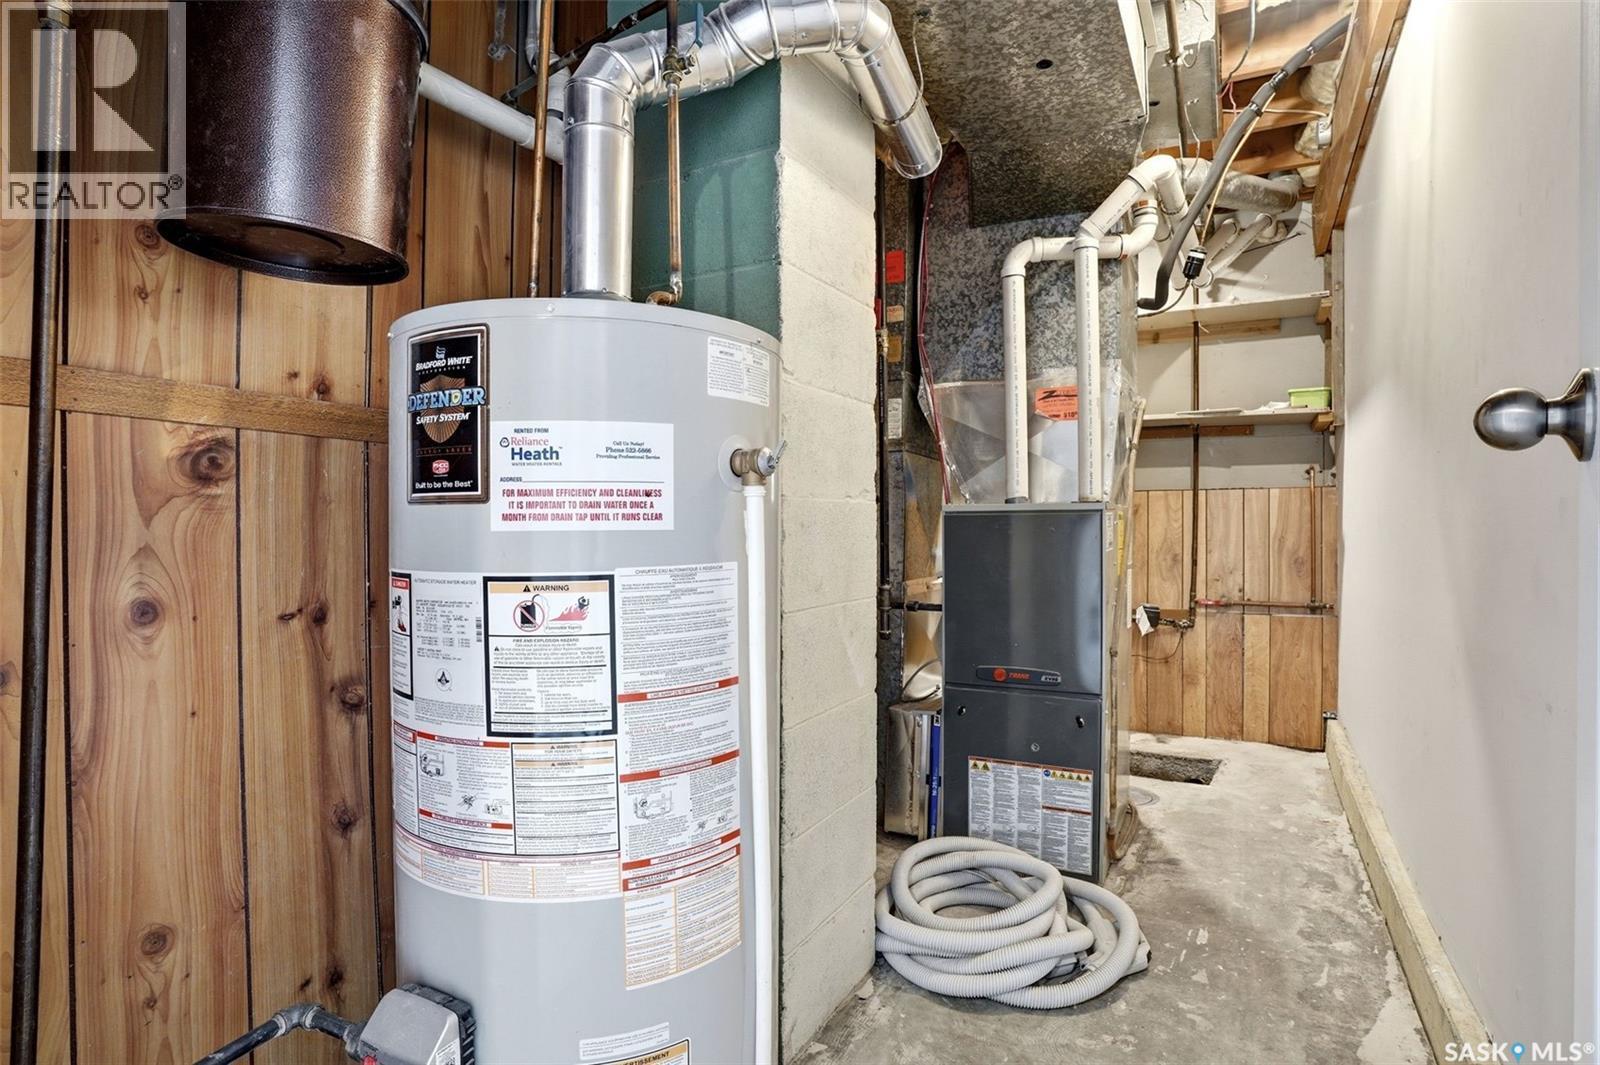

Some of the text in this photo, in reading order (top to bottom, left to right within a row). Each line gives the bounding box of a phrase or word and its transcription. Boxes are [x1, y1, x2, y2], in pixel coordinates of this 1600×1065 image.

[416, 359, 446, 371] BRADFORD
[408, 387, 486, 412] DEFENDER
[416, 415, 439, 425] SAFETY
[511, 436, 549, 446] Reliance
[442, 480, 453, 488] the
[502, 488, 663, 498] FOR MAXIMUM EFFICIENCY AND CLEANLINESS
[508, 500, 655, 510] IT IS IMPORTANT TO DRAIN WATER ONCE A
[501, 512, 664, 521] MONTH FROM DRAIN TAP UNTIL IT RUNS CLEAR
[533, 584, 570, 592] WARNING
